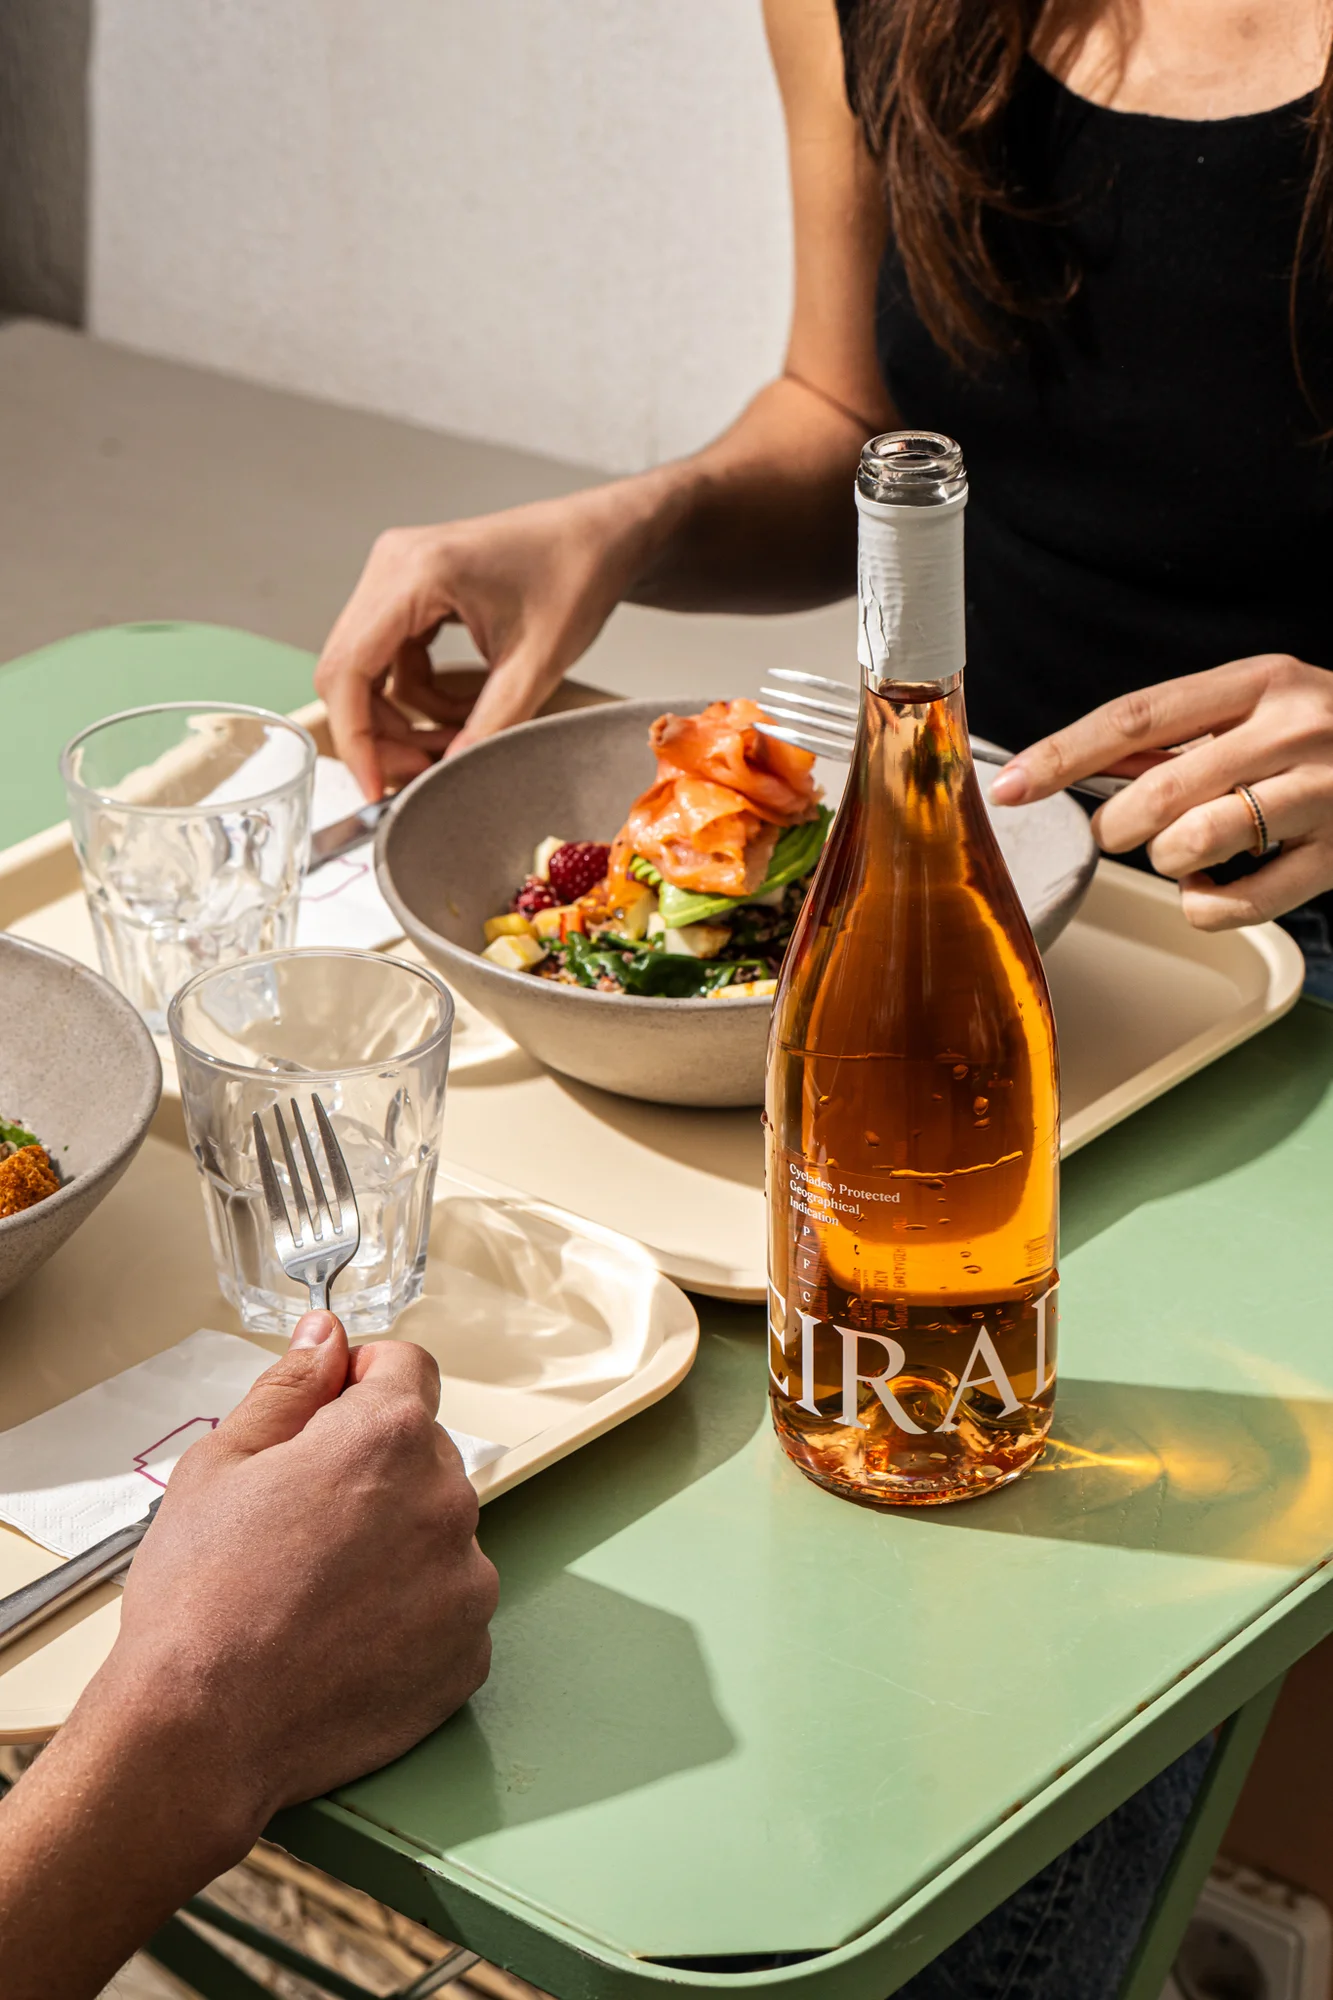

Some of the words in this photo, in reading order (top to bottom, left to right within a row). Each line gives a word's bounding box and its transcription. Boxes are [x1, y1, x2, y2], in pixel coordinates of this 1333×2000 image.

[789, 1163, 836, 1194] Cyclades,
[841, 1183, 900, 1204] Protected
[789, 1179, 860, 1215] Geographical
[790, 1196, 839, 1226] Indication
[803, 1225, 811, 1237] P
[803, 1257, 811, 1269] F
[802, 1291, 811, 1303] C
